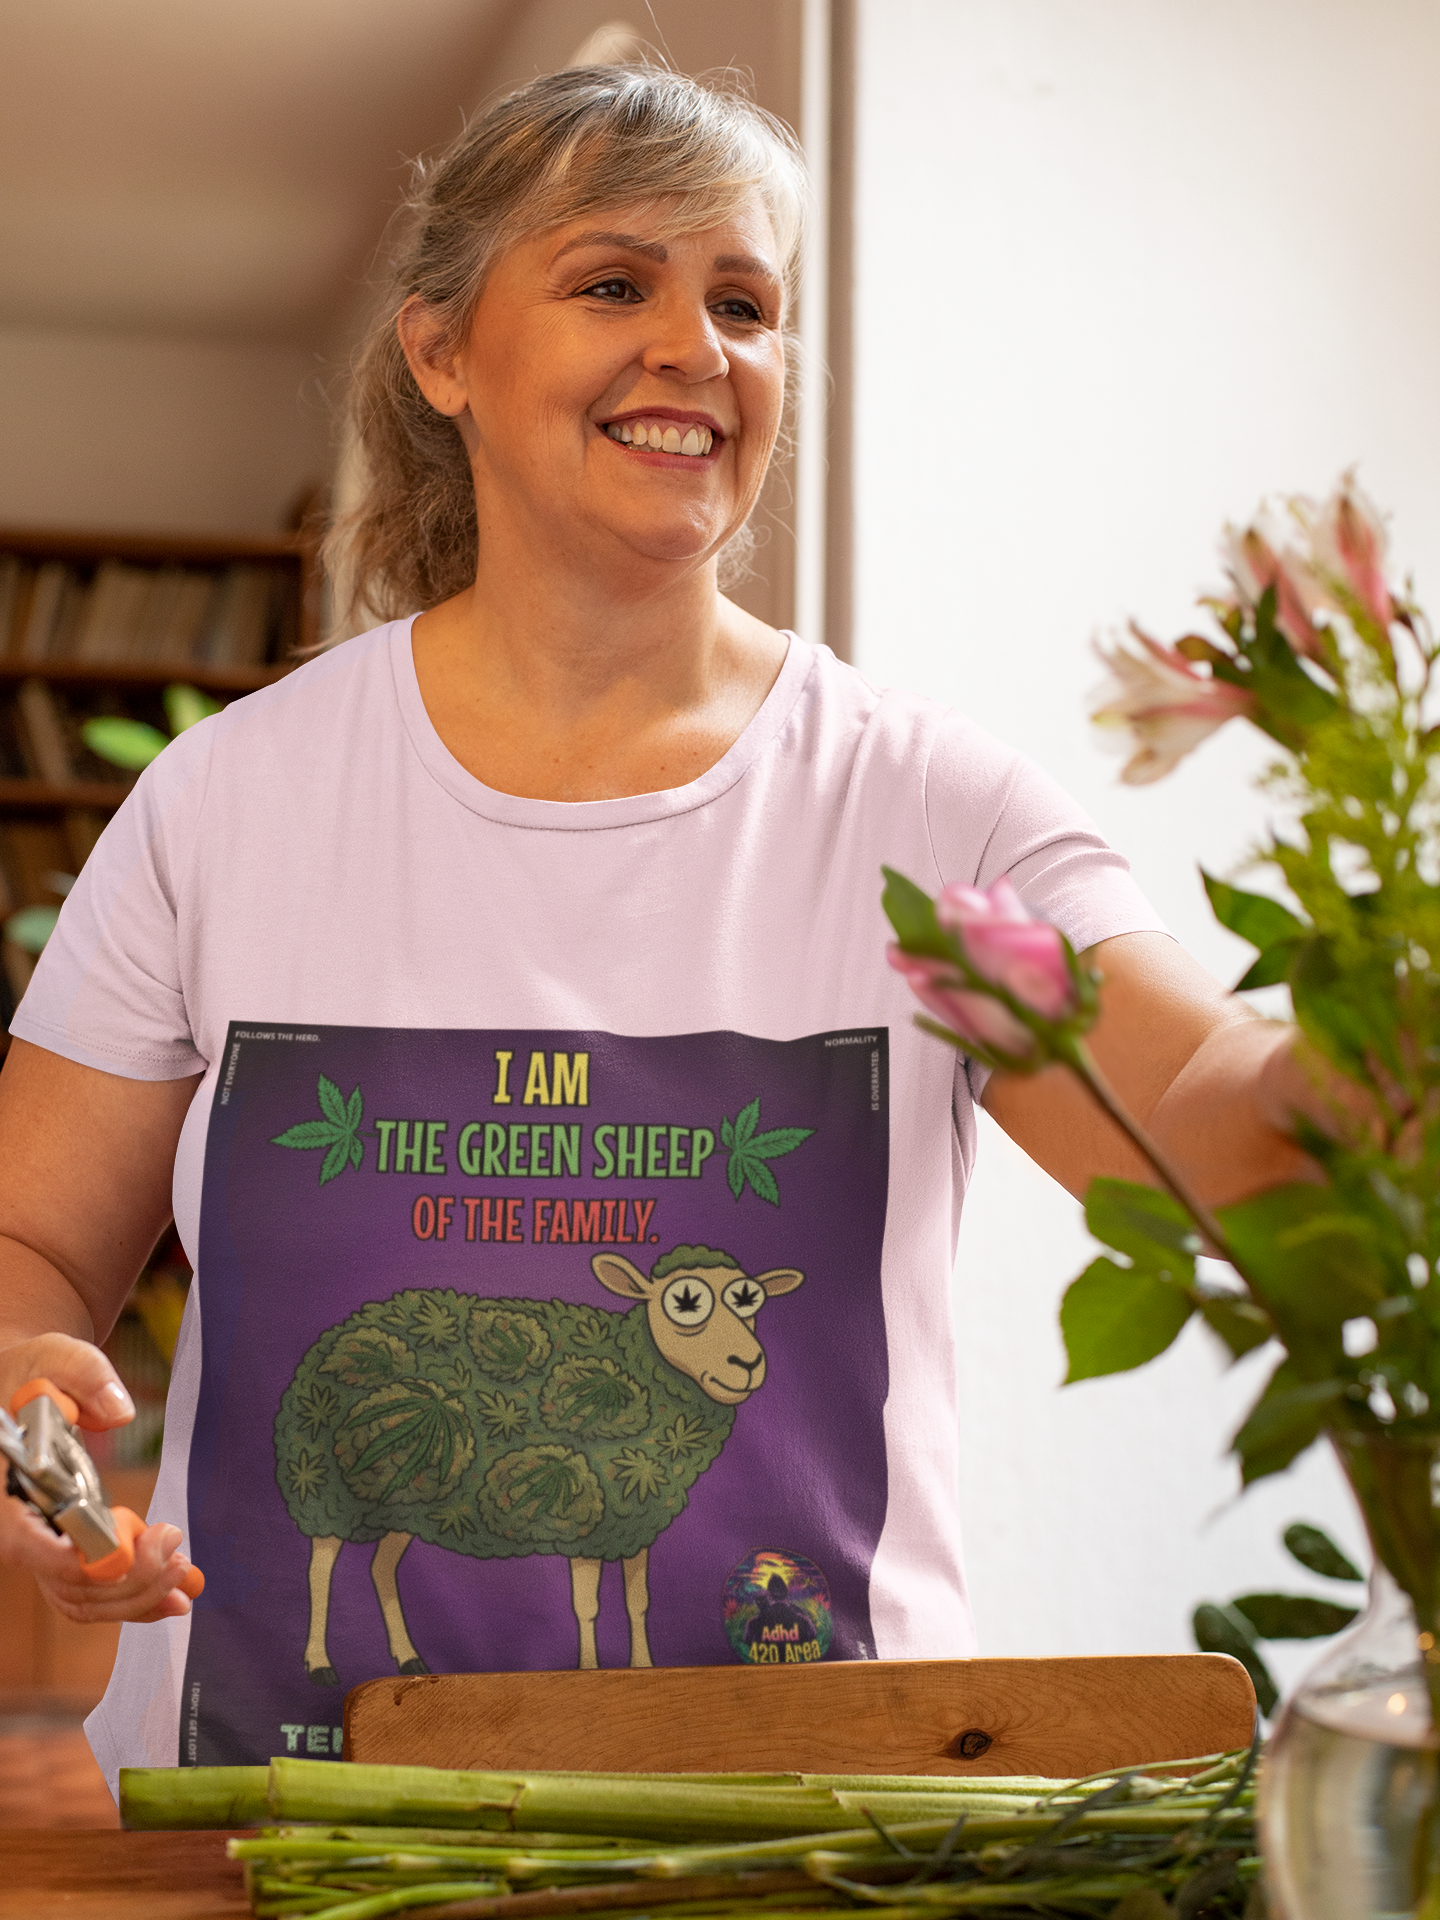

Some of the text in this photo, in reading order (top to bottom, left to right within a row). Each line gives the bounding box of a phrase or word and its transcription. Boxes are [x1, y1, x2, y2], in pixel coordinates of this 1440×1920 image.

[235, 1031, 320, 1042] FOLLOWS THE HERD.
[825, 1035, 878, 1047] NORMALITY
[221, 1043, 240, 1105] NOT EVERYONE
[492, 1050, 590, 1106] I AM
[871, 1103, 879, 1111] IS
[375, 1120, 716, 1178] THE GREEN SHEEP
[412, 1195, 660, 1244] OF THE FAMILY.
[762, 1623, 799, 1641] Adhd
[749, 1639, 821, 1663] 420 Area
[189, 1719, 198, 1737] GET
[188, 1739, 197, 1762] LOST
